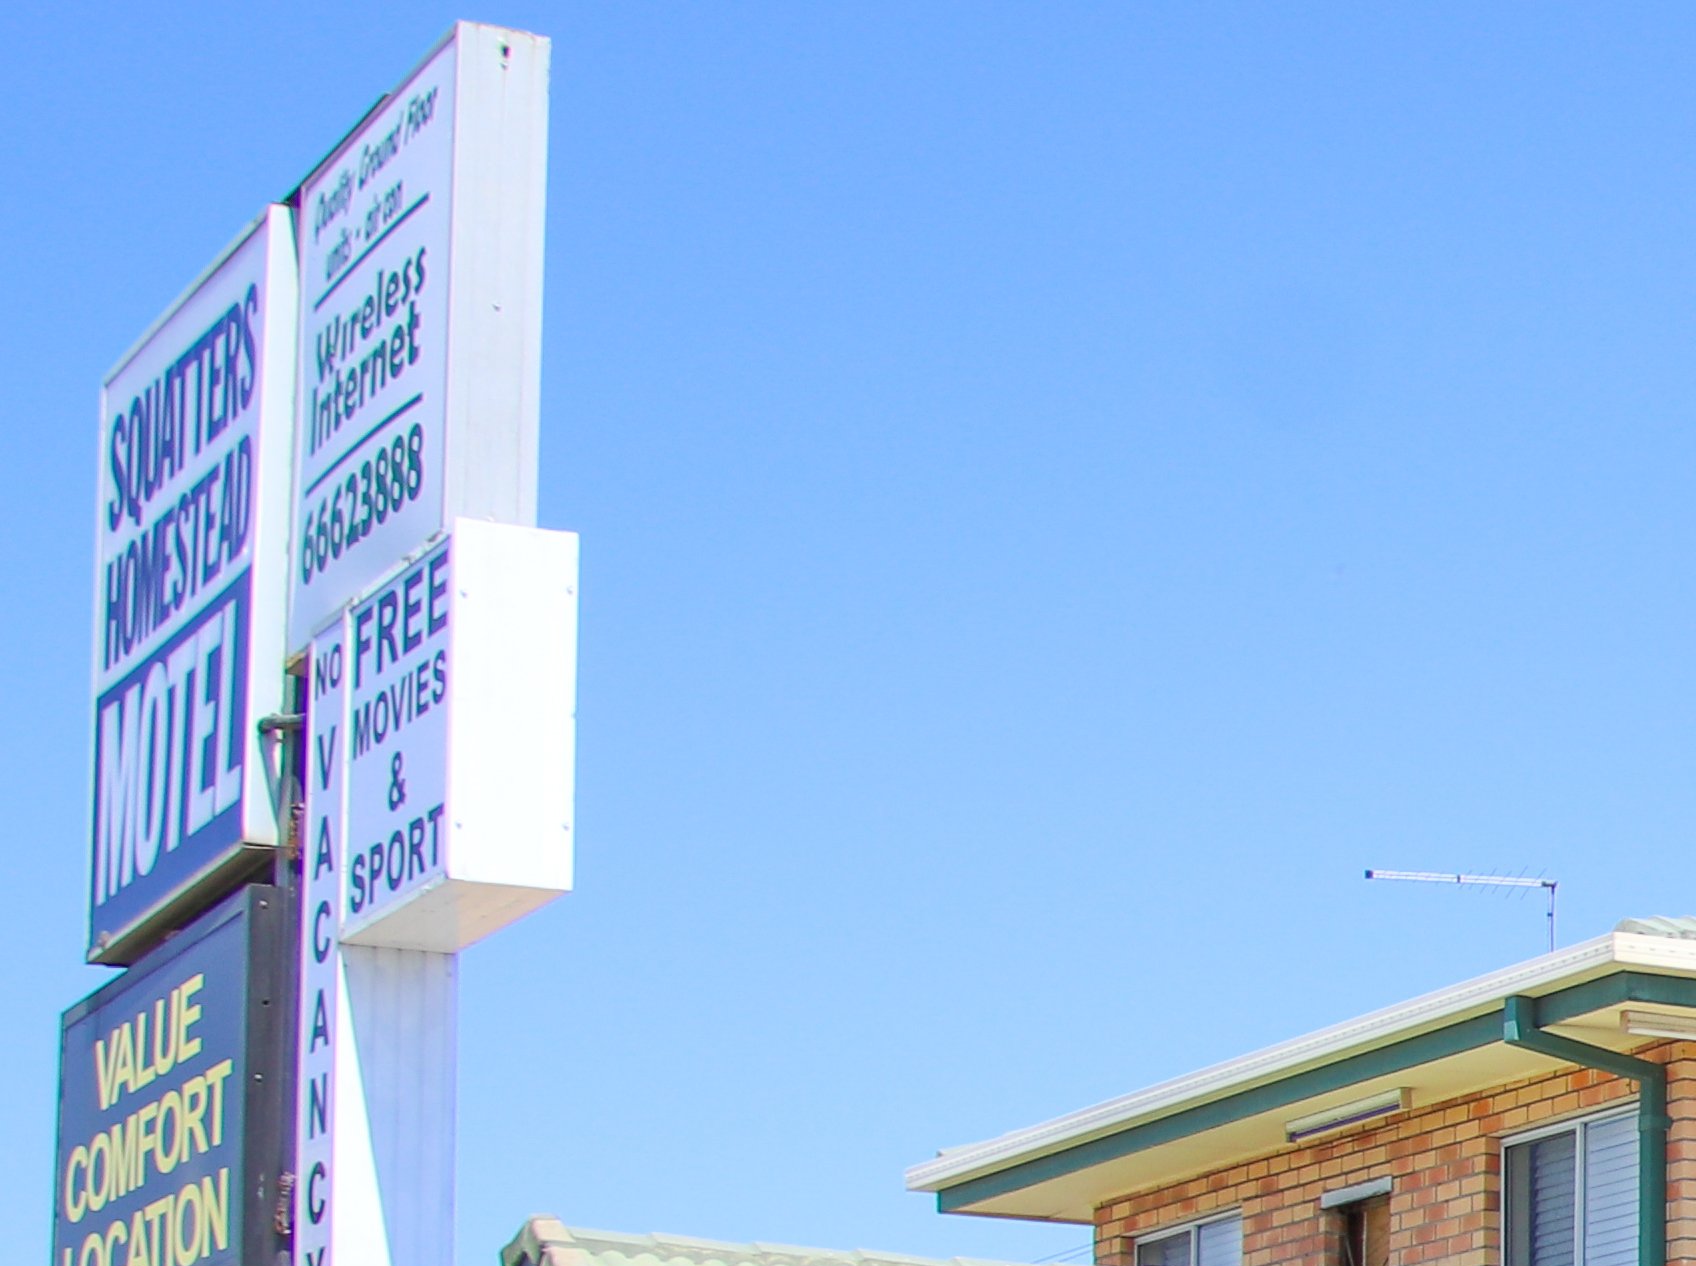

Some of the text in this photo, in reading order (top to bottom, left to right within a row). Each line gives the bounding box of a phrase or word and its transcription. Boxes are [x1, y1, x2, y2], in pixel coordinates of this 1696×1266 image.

[358, 112, 404, 191] Ground
[403, 86, 438, 146] Floor
[316, 246, 427, 383] Wireless
[326, 228, 351, 282] units
[109, 282, 258, 533] SQUATTERS
[310, 300, 421, 457] Internet
[104, 434, 253, 672] HOMESTEAD
[302, 422, 423, 586] 66623888
[314, 643, 342, 701] NO
[355, 551, 448, 690] FREE
[96, 599, 243, 907] MOTEL
[352, 649, 447, 760] MOVIES
[388, 751, 407, 812] &
[350, 802, 445, 914] SPORT
[96, 973, 204, 1111] VALUE
[65, 1058, 233, 1224] COMFORT
